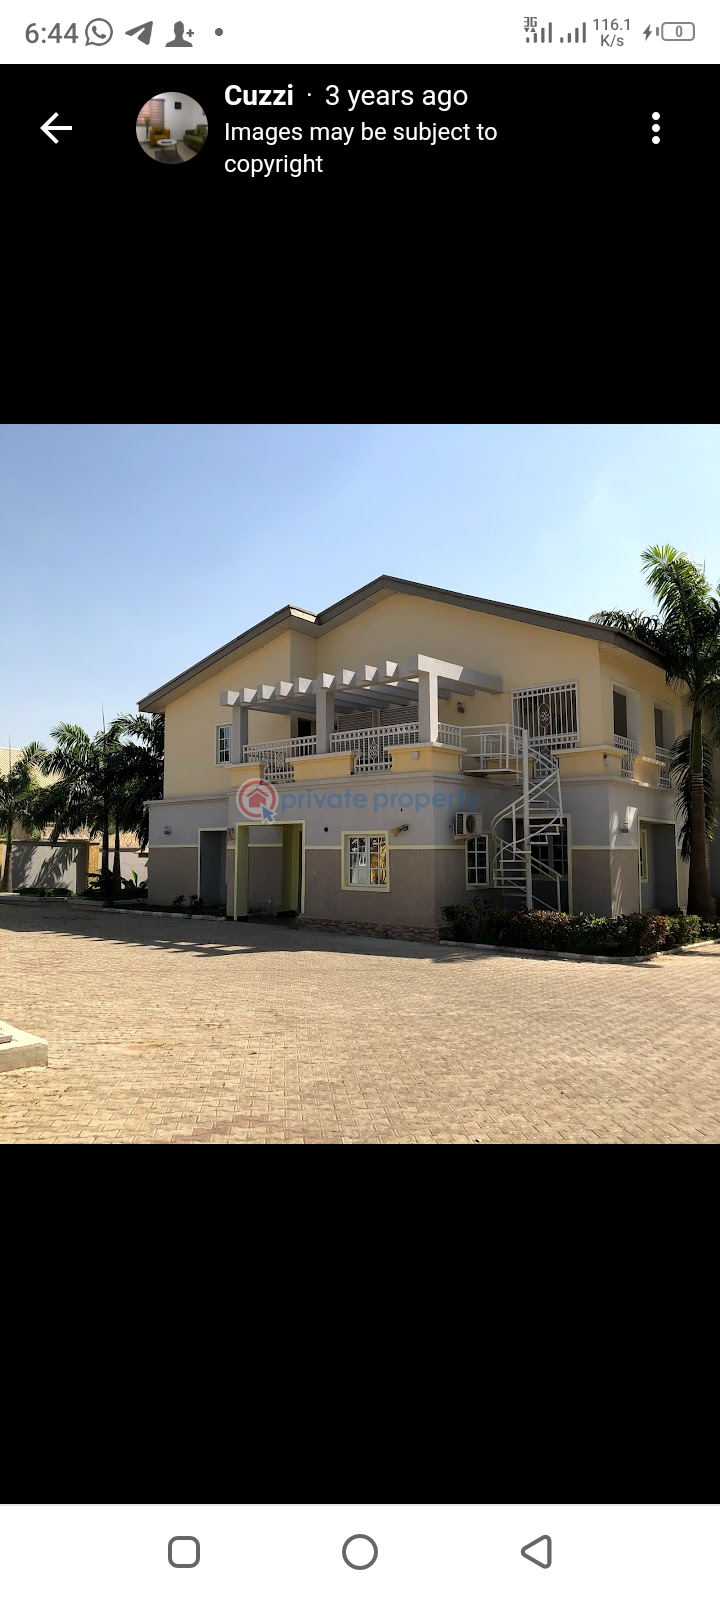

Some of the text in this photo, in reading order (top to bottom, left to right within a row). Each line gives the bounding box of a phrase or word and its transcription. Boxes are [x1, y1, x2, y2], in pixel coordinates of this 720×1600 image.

[524, 16, 538, 27] 3G
[593, 18, 630, 31] 116.1
[25, 22, 79, 44] 6:44
[600, 34, 625, 47] K/s
[224, 83, 469, 112] Cuzzi 3 years ago
[225, 121, 498, 146] Images may be subject to
[224, 153, 324, 178] copyright
